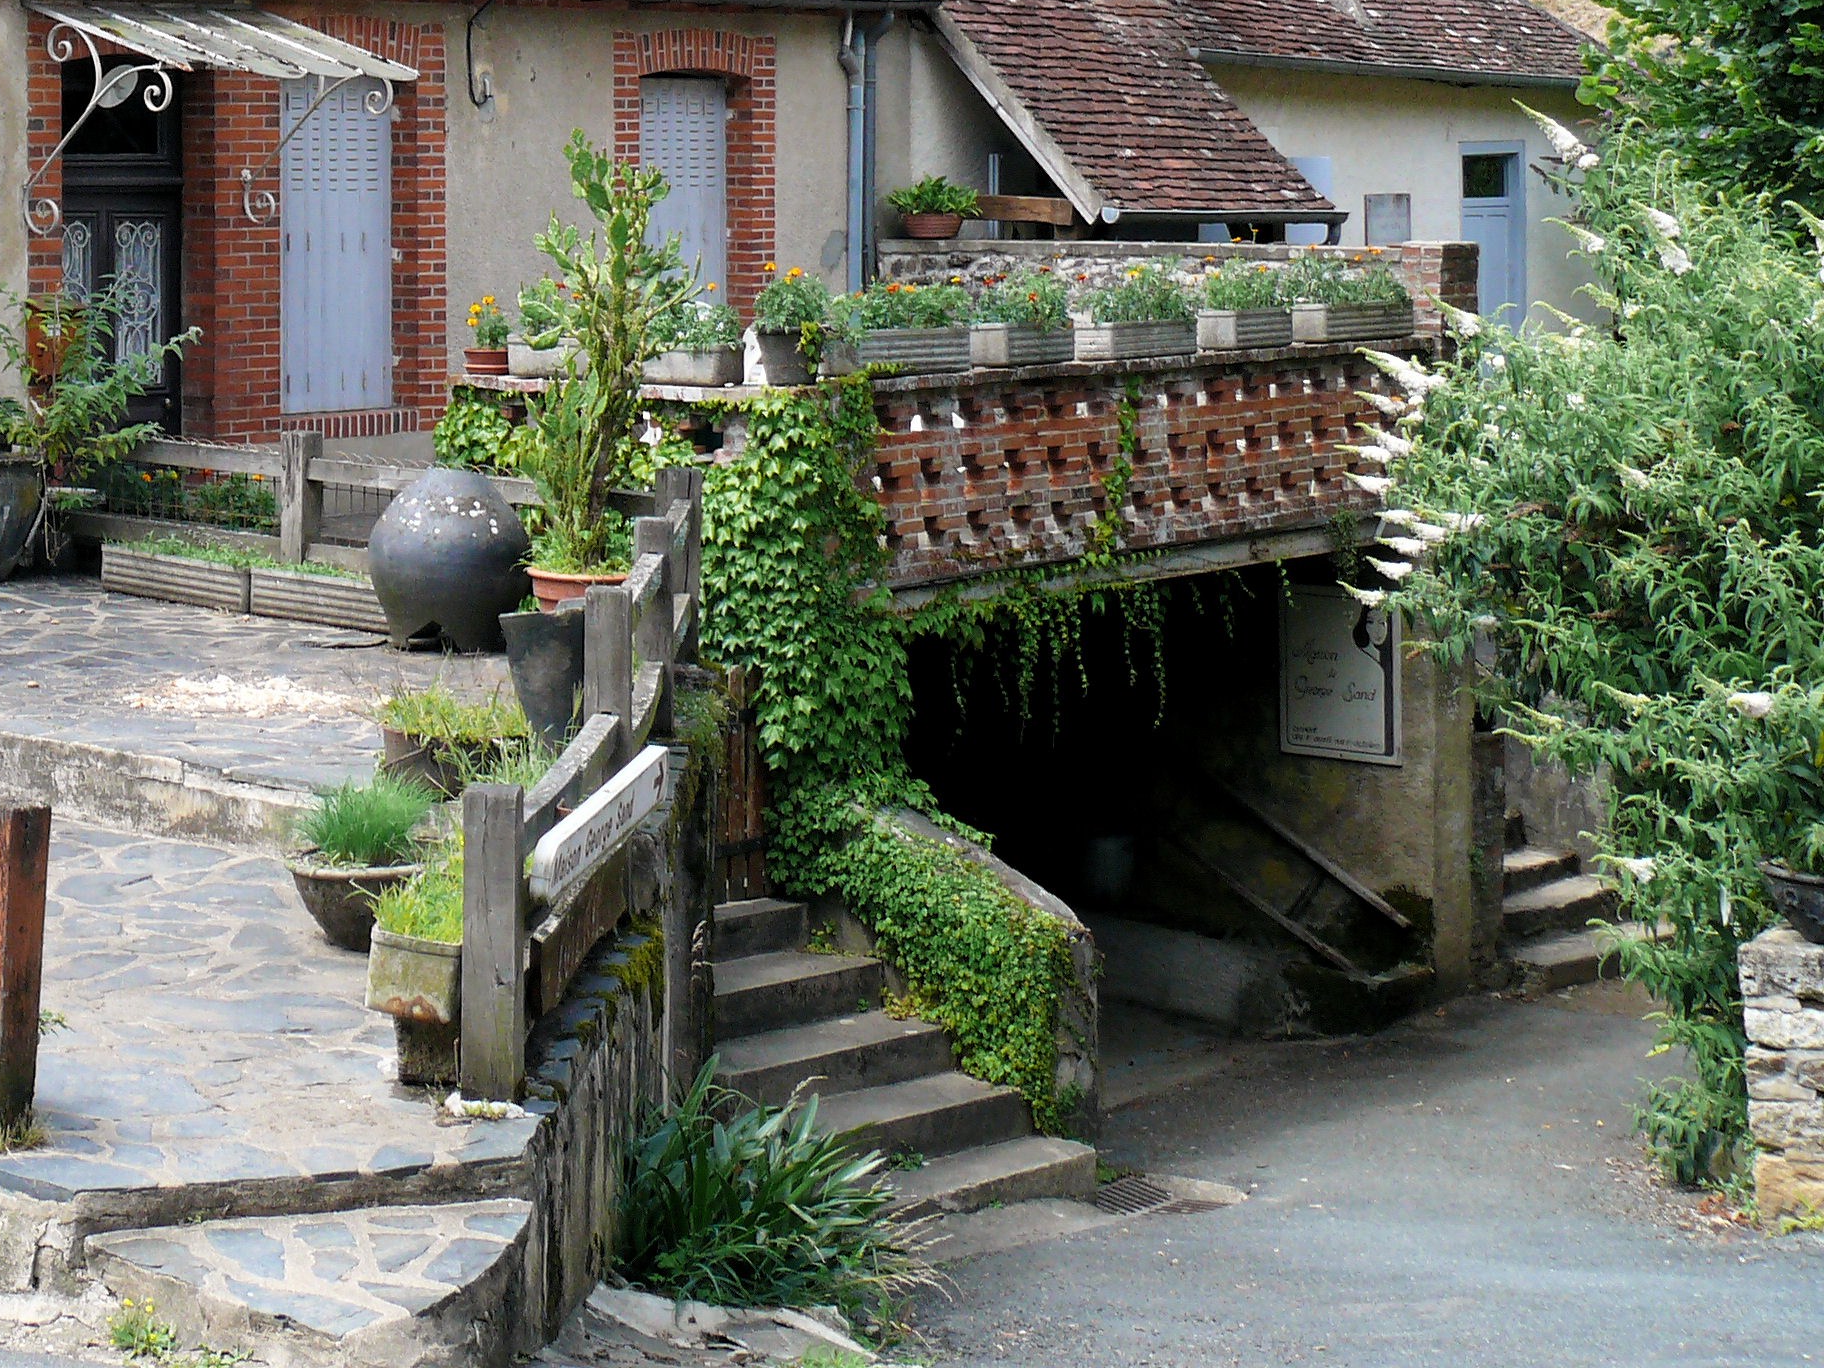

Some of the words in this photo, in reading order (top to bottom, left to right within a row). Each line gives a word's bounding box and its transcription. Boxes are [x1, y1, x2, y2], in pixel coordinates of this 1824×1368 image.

[1342, 682, 1377, 703] Sand
[550, 845, 582, 887] Maison
[616, 788, 635, 830] Sand
